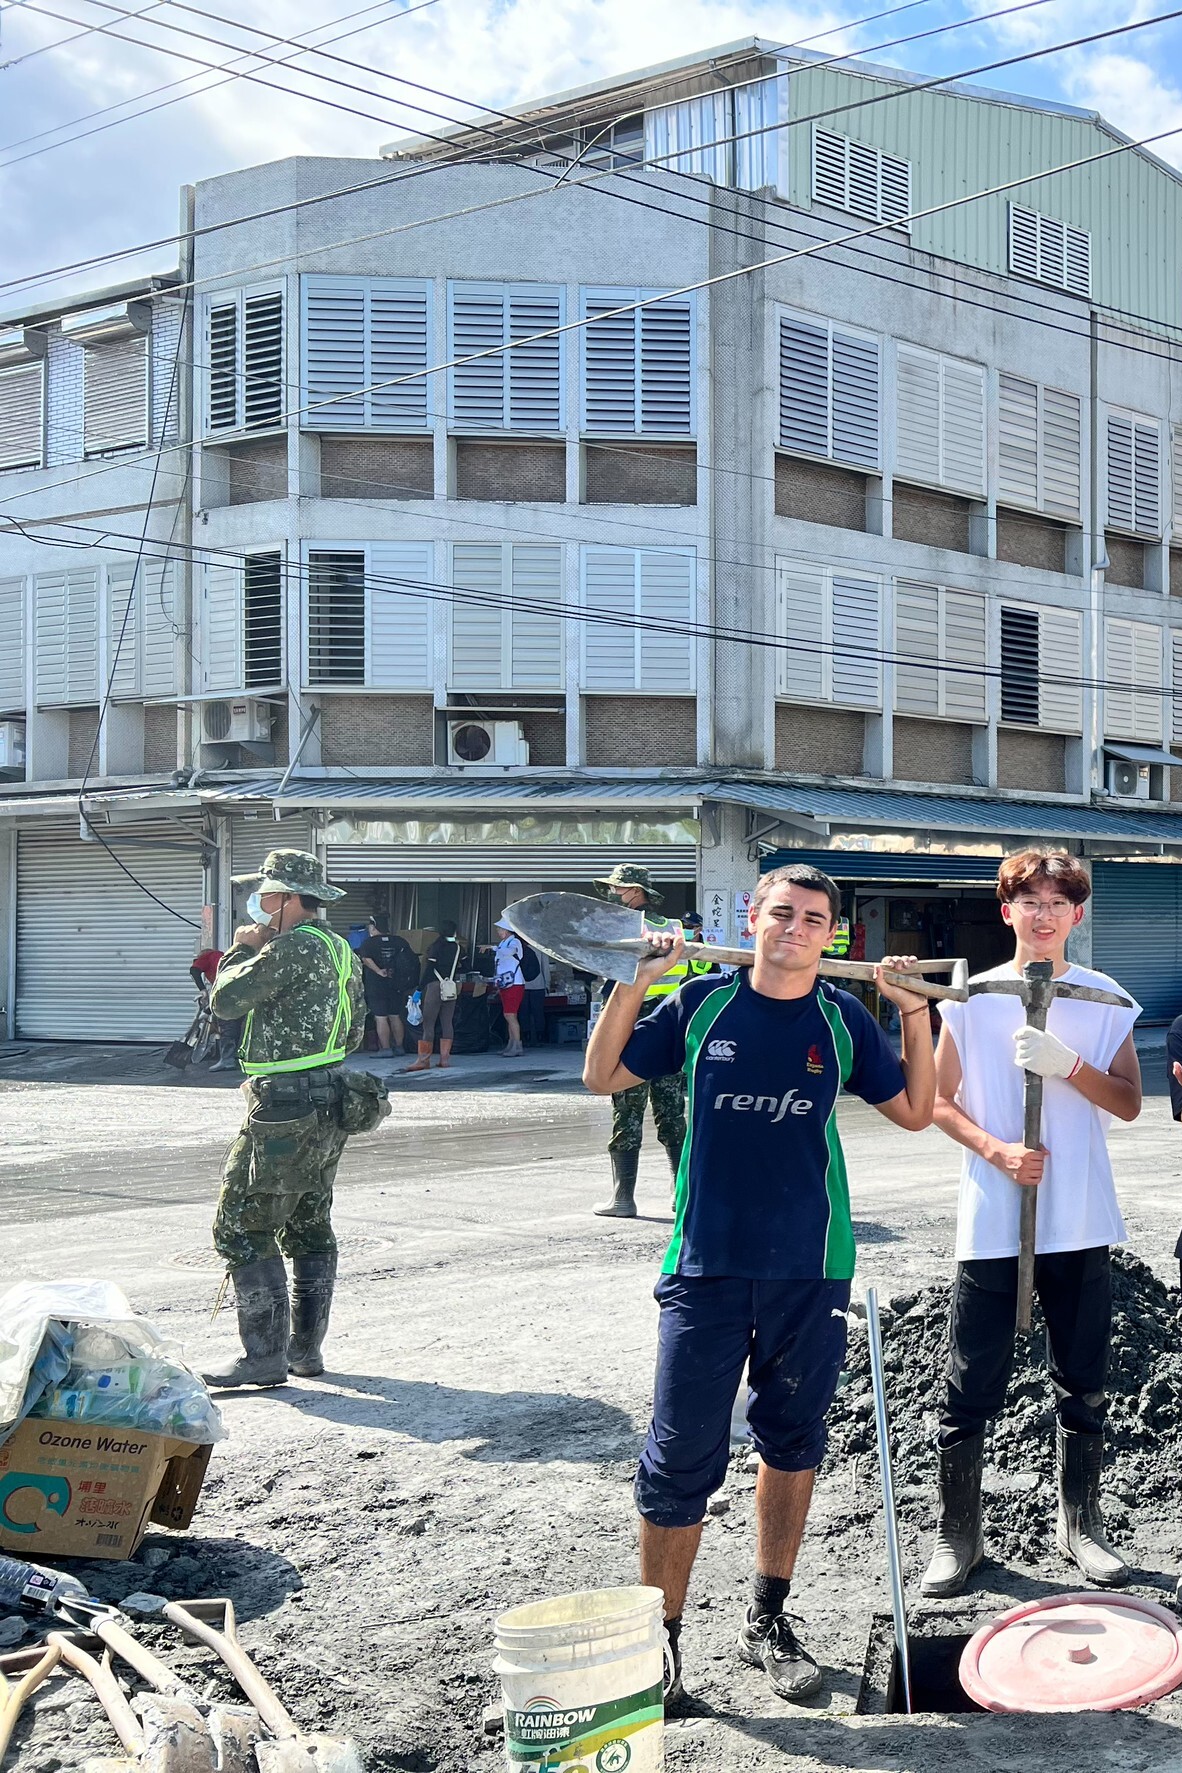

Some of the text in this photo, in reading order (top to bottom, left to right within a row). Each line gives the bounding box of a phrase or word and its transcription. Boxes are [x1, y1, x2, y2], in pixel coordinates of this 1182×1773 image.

[705, 1055, 735, 1063] canterbury
[713, 1088, 813, 1123] renfe
[38, 1431, 147, 1455] Ozone Water
[515, 1707, 597, 1728] RAINBOW
